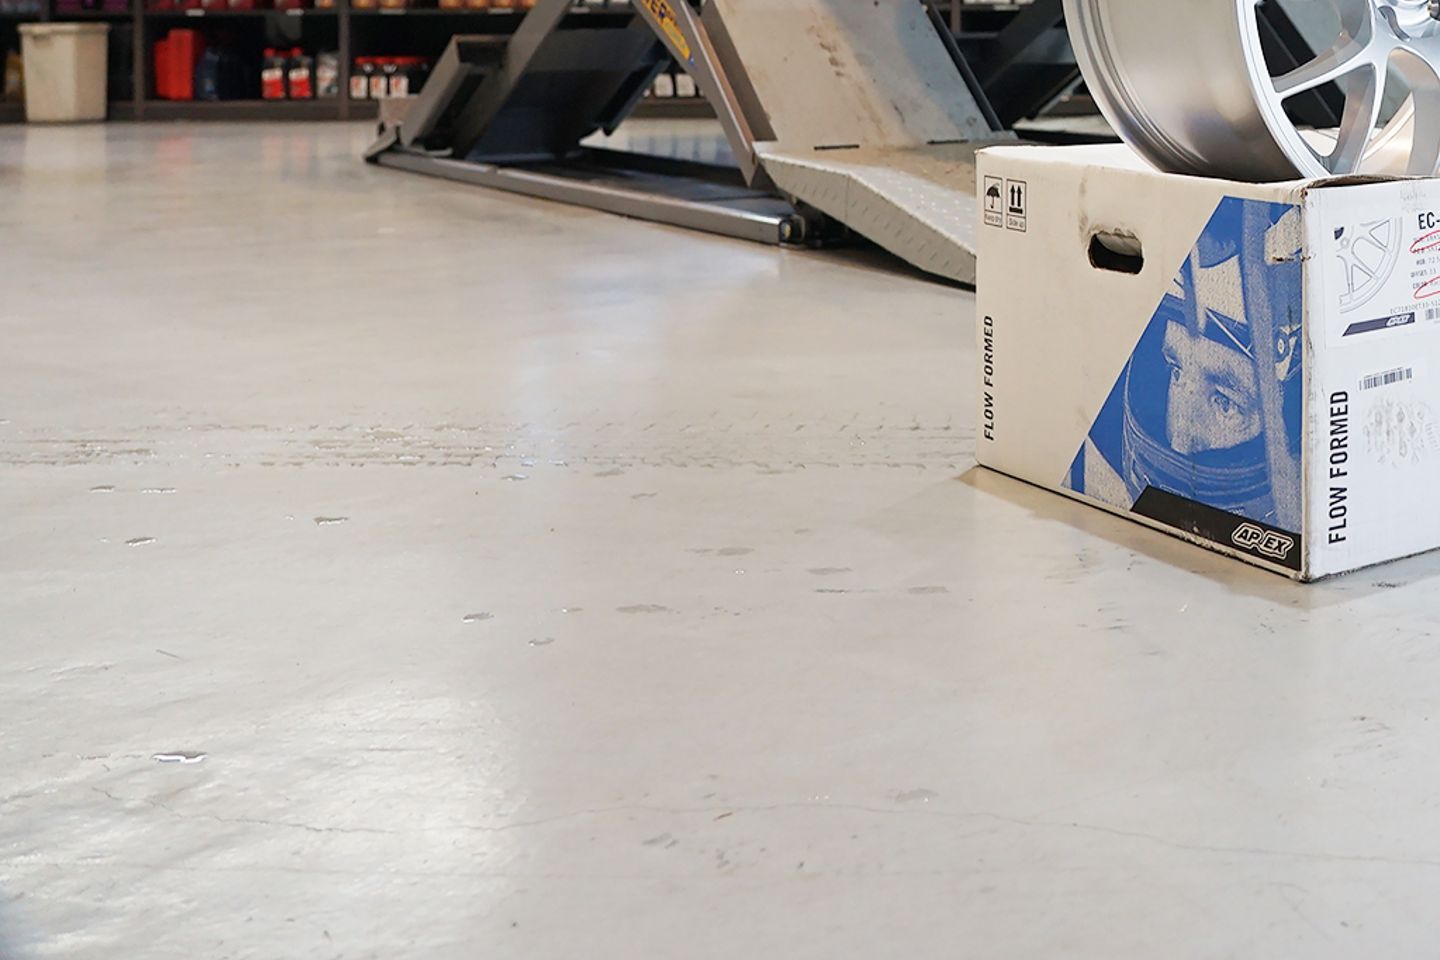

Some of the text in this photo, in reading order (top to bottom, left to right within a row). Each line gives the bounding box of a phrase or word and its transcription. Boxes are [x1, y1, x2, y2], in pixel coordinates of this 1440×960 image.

[983, 315, 994, 441] FLOW FORMED
[1328, 391, 1348, 544] FLOW FORMED
[1234, 526, 1291, 556] APEX
